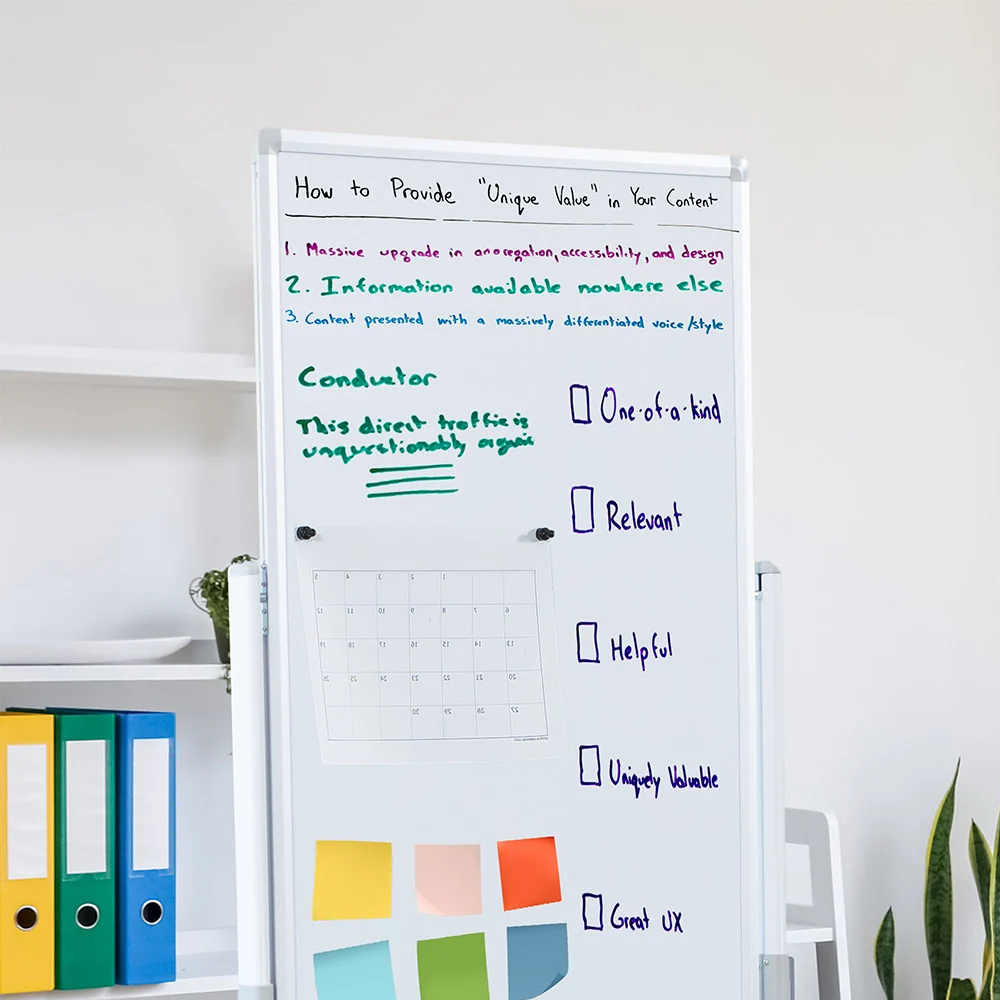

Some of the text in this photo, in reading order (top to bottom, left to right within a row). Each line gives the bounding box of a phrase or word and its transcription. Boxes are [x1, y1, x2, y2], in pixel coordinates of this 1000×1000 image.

[295, 176, 332, 199] How
[350, 180, 369, 197] to
[390, 177, 456, 204] Provide
[607, 194, 620, 208] in
[630, 187, 656, 206] Your
[666, 188, 718, 208] Content
[285, 241, 296, 255] 1.
[306, 242, 364, 257] Massive
[380, 245, 439, 263] upgrade
[449, 248, 463, 257] in
[652, 245, 675, 260] and
[681, 244, 724, 265] design
[285, 274, 723, 296] 2. Information available nowhere else
[285, 309, 298, 323] 3.
[305, 312, 356, 325] Content
[364, 312, 424, 328] presented
[437, 314, 467, 325] with
[496, 314, 554, 330] massively
[564, 315, 644, 328] differentiated
[298, 366, 437, 388] Conductor
[296, 411, 529, 435] This direct traffic is
[606, 500, 682, 531] Relevant
[611, 632, 672, 671] Helpful
[609, 759, 718, 799] Uniquely Valuable
[610, 903, 683, 933] Great UX
